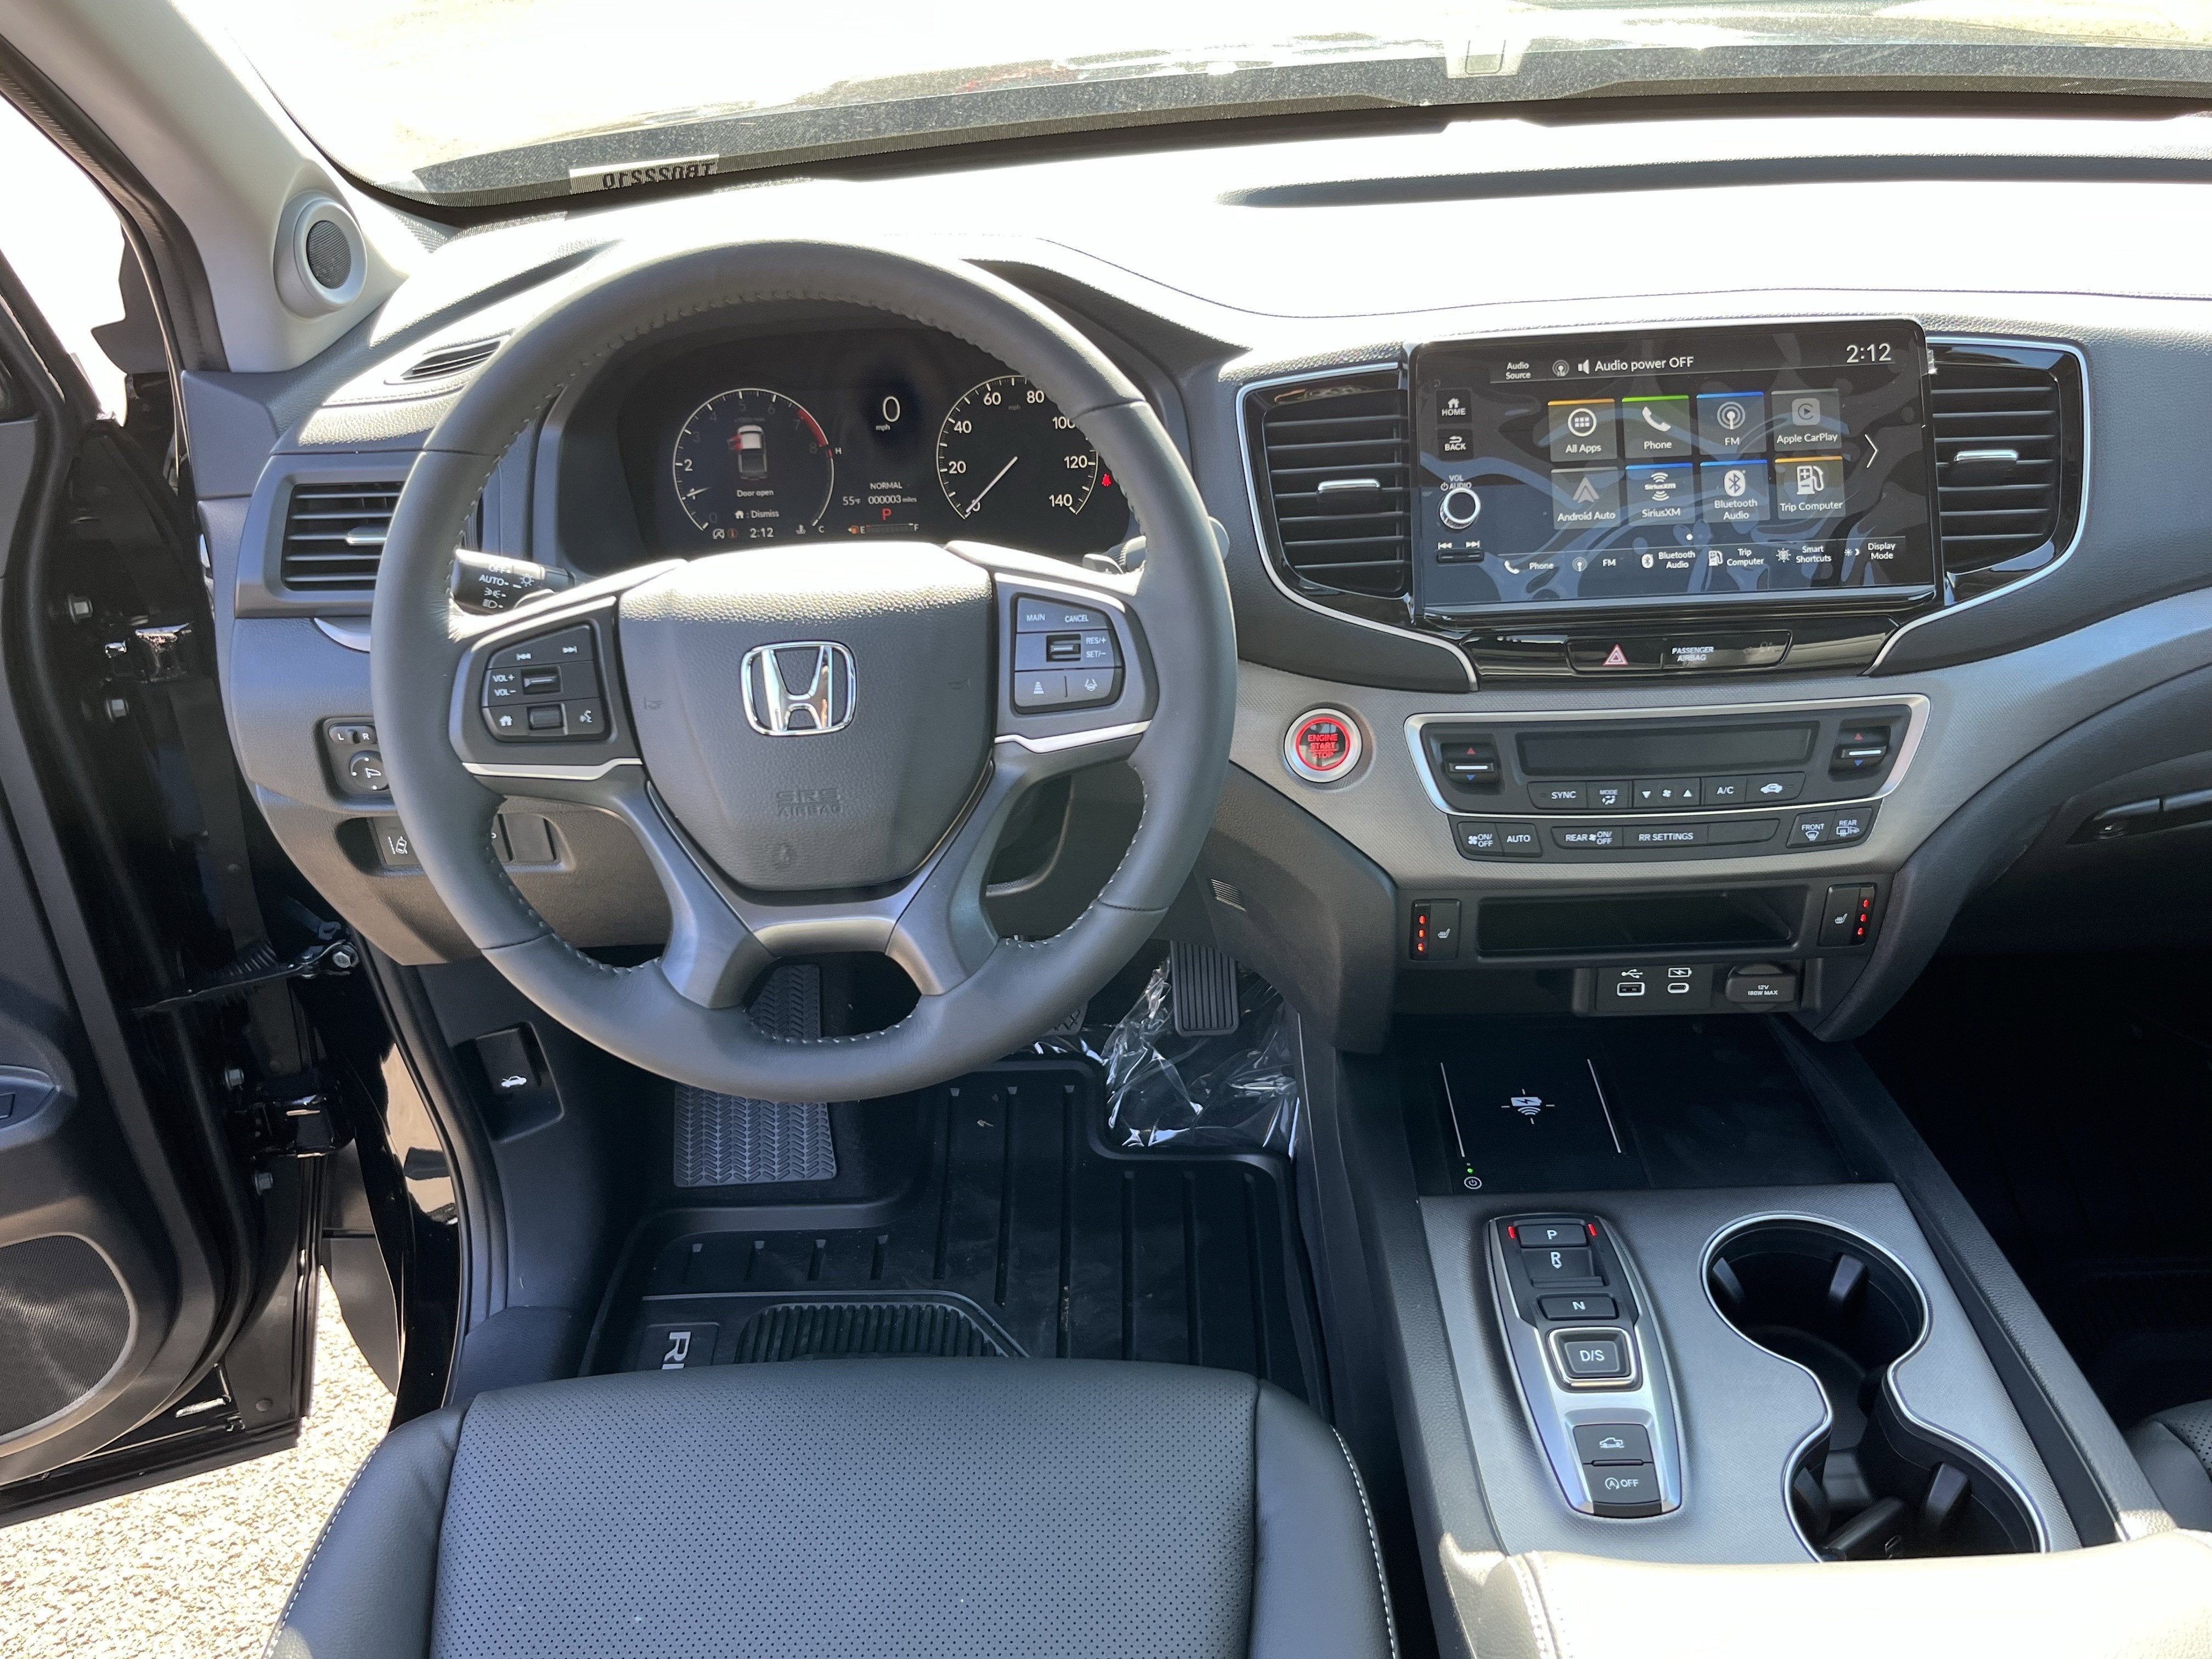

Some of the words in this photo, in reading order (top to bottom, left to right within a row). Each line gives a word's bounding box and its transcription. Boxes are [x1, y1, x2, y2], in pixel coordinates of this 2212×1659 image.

[1846, 343, 1892, 364] 2:12
[1506, 361, 1530, 370] Audio
[1594, 360, 1628, 372] Audio
[1630, 358, 1666, 371] power
[1669, 356, 1694, 368] OFF
[1505, 371, 1531, 380] Source
[983, 392, 1002, 405] 60
[1026, 390, 1045, 404] 80
[882, 396, 900, 422] 0
[1441, 408, 1466, 417] HOME
[953, 420, 972, 433] 40
[1725, 437, 1740, 446] FM
[1776, 435, 1802, 445] Apple
[1804, 432, 1838, 443] CarPlay
[1444, 442, 1466, 452] BACK
[1566, 444, 1578, 454] All
[1579, 443, 1601, 454] Apps
[1644, 441, 1672, 450] Phone
[684, 459, 692, 471] 2
[1064, 455, 1088, 469] 120
[949, 461, 967, 474] 20
[870, 482, 902, 490] NORMAL
[868, 495, 901, 504] 000003
[1049, 494, 1073, 507] 140
[1714, 499, 1758, 509] Bluetooth
[1780, 503, 1797, 512] Trip
[1798, 501, 1843, 512] Computer
[751, 510, 779, 518] Dismiss
[882, 507, 892, 521] P
[1557, 512, 1593, 522] Android
[1594, 511, 1616, 520] Auto
[1641, 507, 1681, 517] SiriusXM
[1723, 511, 1750, 520] Audio
[750, 527, 774, 538] 2:12
[1802, 545, 1824, 554] Smart
[1868, 542, 1896, 552] Display
[1658, 550, 1695, 560] Bluetooth
[1737, 548, 1752, 558] Trip
[1871, 551, 1893, 560] Mode
[1602, 558, 1616, 567] FM
[1726, 557, 1764, 567] Computer
[1796, 554, 1831, 563] Shortcuts
[1529, 561, 1554, 571] Phone
[1666, 560, 1689, 569] Audio
[479, 574, 505, 586] AUTO
[1026, 614, 1046, 622] MAIN
[1064, 614, 1089, 623] CANCEL
[1310, 742, 1335, 750] START
[1551, 791, 1576, 800] SYNC
[1717, 786, 1734, 795] A/C
[1506, 834, 1531, 843] AUTO
[1565, 833, 1587, 842] REAR
[1638, 833, 1651, 842] RR
[1652, 832, 1694, 841] SETTINGS
[1547, 1229, 1557, 1239] P
[1550, 1251, 1561, 1263] R
[1572, 1301, 1585, 1310] N
[1579, 1350, 1605, 1362] D/S
[1620, 1479, 1638, 1487] OFF
